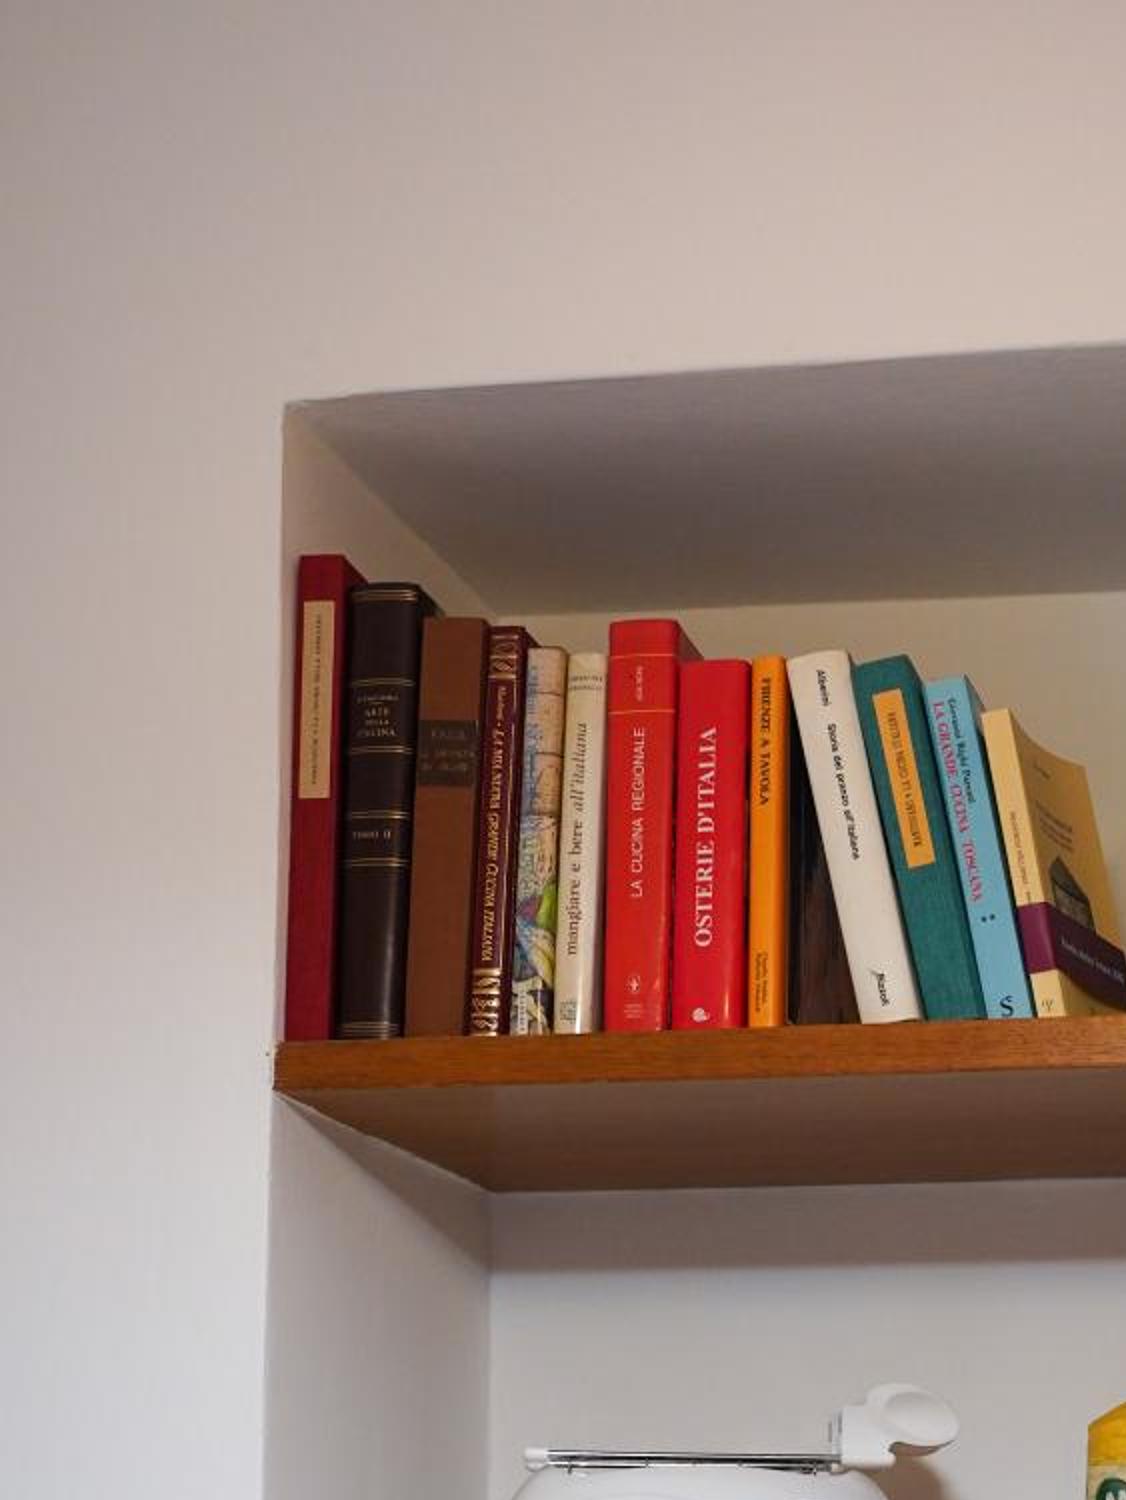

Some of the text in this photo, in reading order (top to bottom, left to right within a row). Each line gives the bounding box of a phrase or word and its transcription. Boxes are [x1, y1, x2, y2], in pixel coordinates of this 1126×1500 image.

[761, 677, 772, 732] FIRENZE
[827, 723, 839, 753] Storia
[833, 755, 843, 771] del
[760, 752, 771, 806] TAVOLA
[836, 773, 849, 807] pranzo
[933, 702, 982, 902] LA GRANDE CUCINA TOSCANA
[567, 723, 587, 956] mangiare e bere all'italiana
[630, 727, 645, 898] LA CUCINA REGIONALE
[694, 727, 717, 947] OSTERIE D'ITALIA
[484, 862, 498, 907] CUCINA
